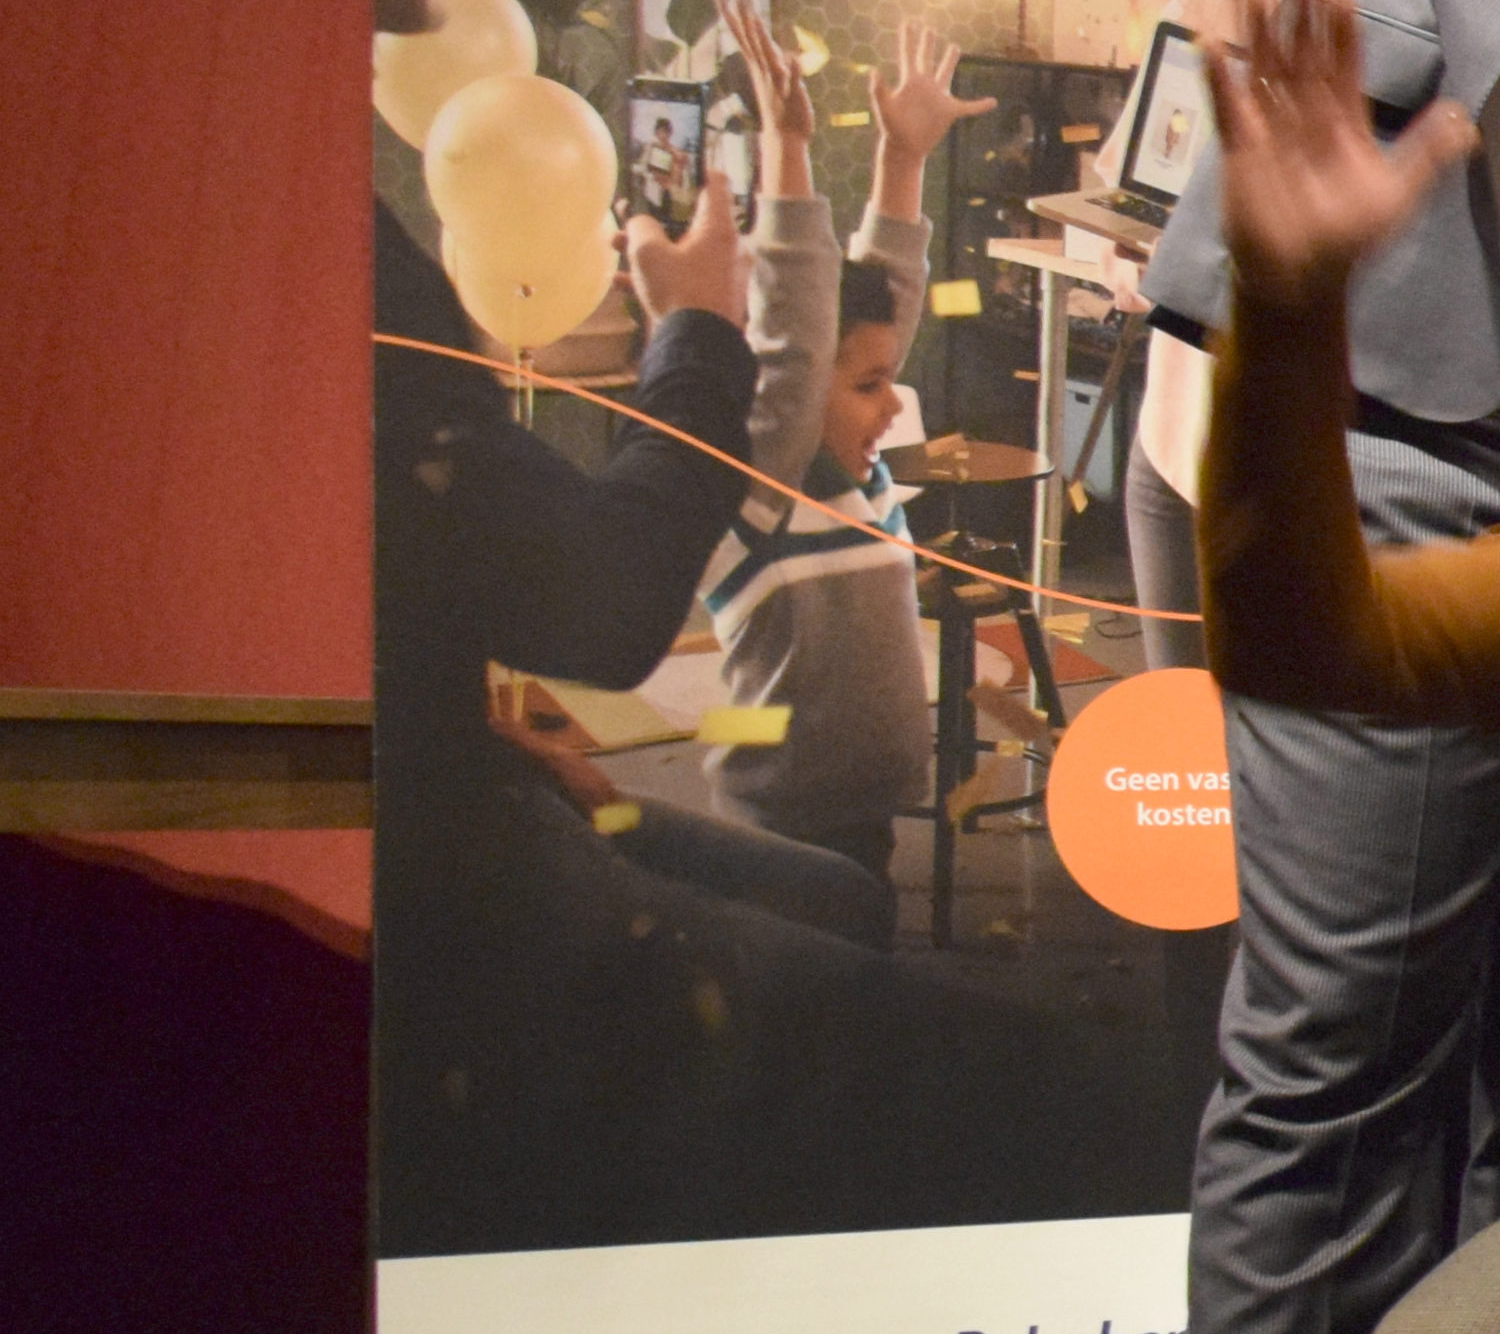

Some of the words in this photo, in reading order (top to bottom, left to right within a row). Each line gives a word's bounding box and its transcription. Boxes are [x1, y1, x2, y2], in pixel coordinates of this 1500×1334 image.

[1105, 767, 1180, 792] Geen
[1187, 772, 1232, 791] vas
[1137, 801, 1232, 827] kosten
